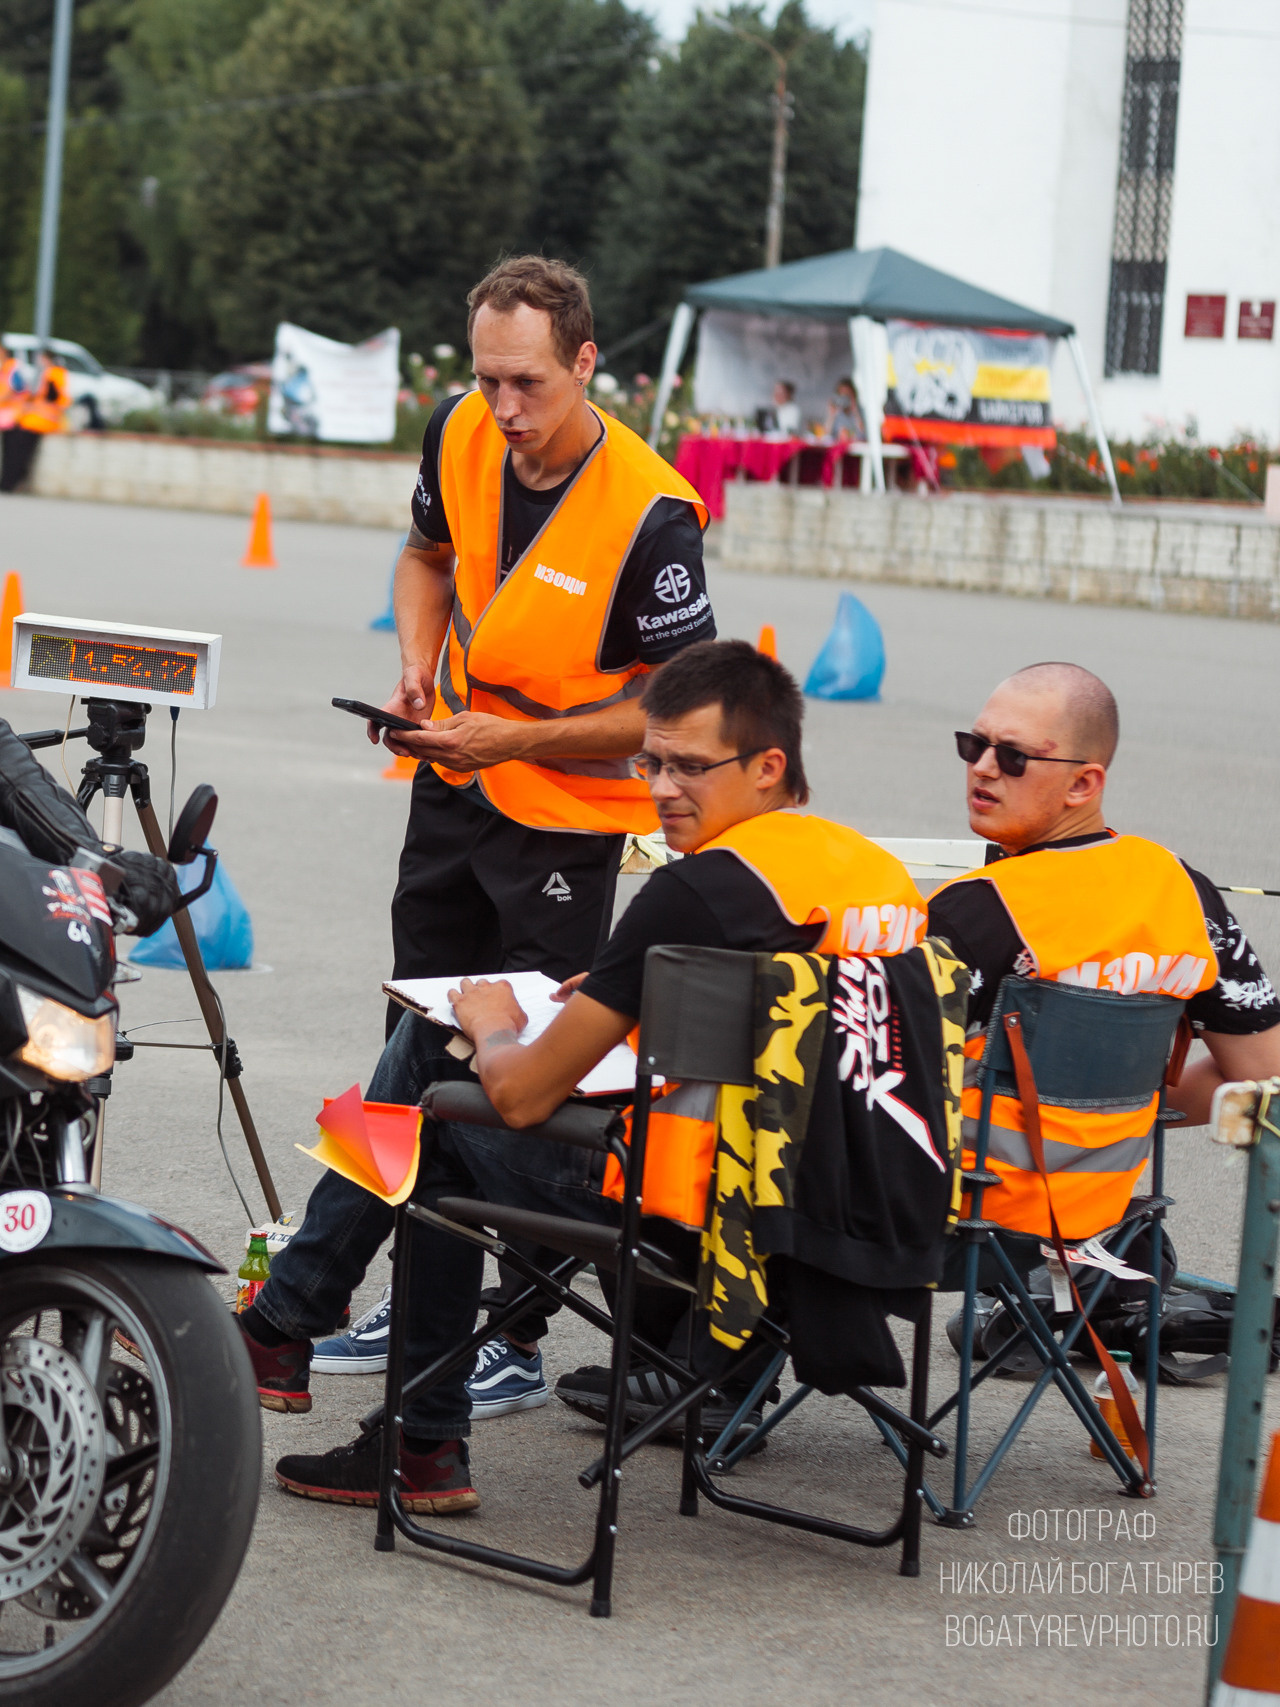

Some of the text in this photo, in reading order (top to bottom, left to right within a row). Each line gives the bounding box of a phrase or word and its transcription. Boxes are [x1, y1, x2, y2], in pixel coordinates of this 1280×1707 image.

[636, 592, 710, 631] Kawasak
[641, 634, 655, 643] Let
[655, 631, 670, 640] the
[671, 621, 694, 637] good
[4, 1203, 36, 1233] 30
